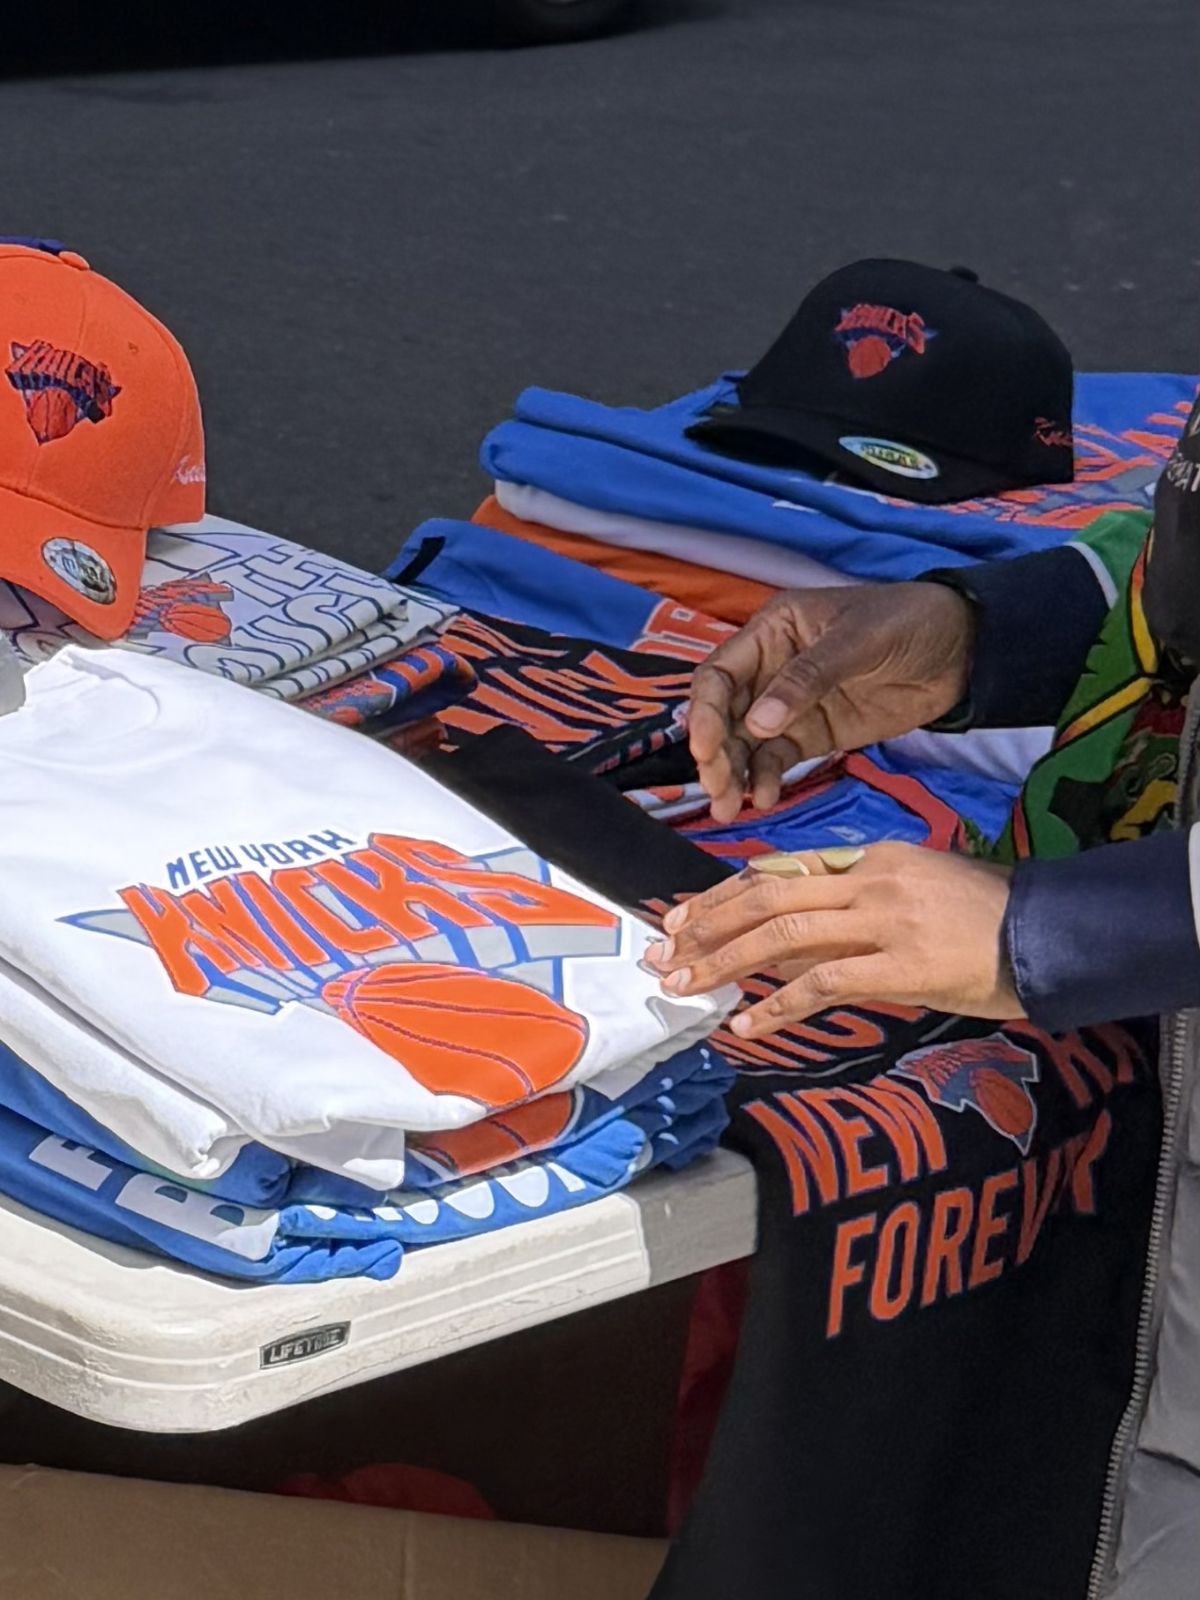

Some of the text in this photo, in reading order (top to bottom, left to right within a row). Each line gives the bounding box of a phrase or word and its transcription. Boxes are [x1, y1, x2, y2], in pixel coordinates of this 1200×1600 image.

[117, 833, 620, 997] KNICKS
[166, 828, 358, 889] NEW YORK
[740, 1075, 948, 1216] NEW
